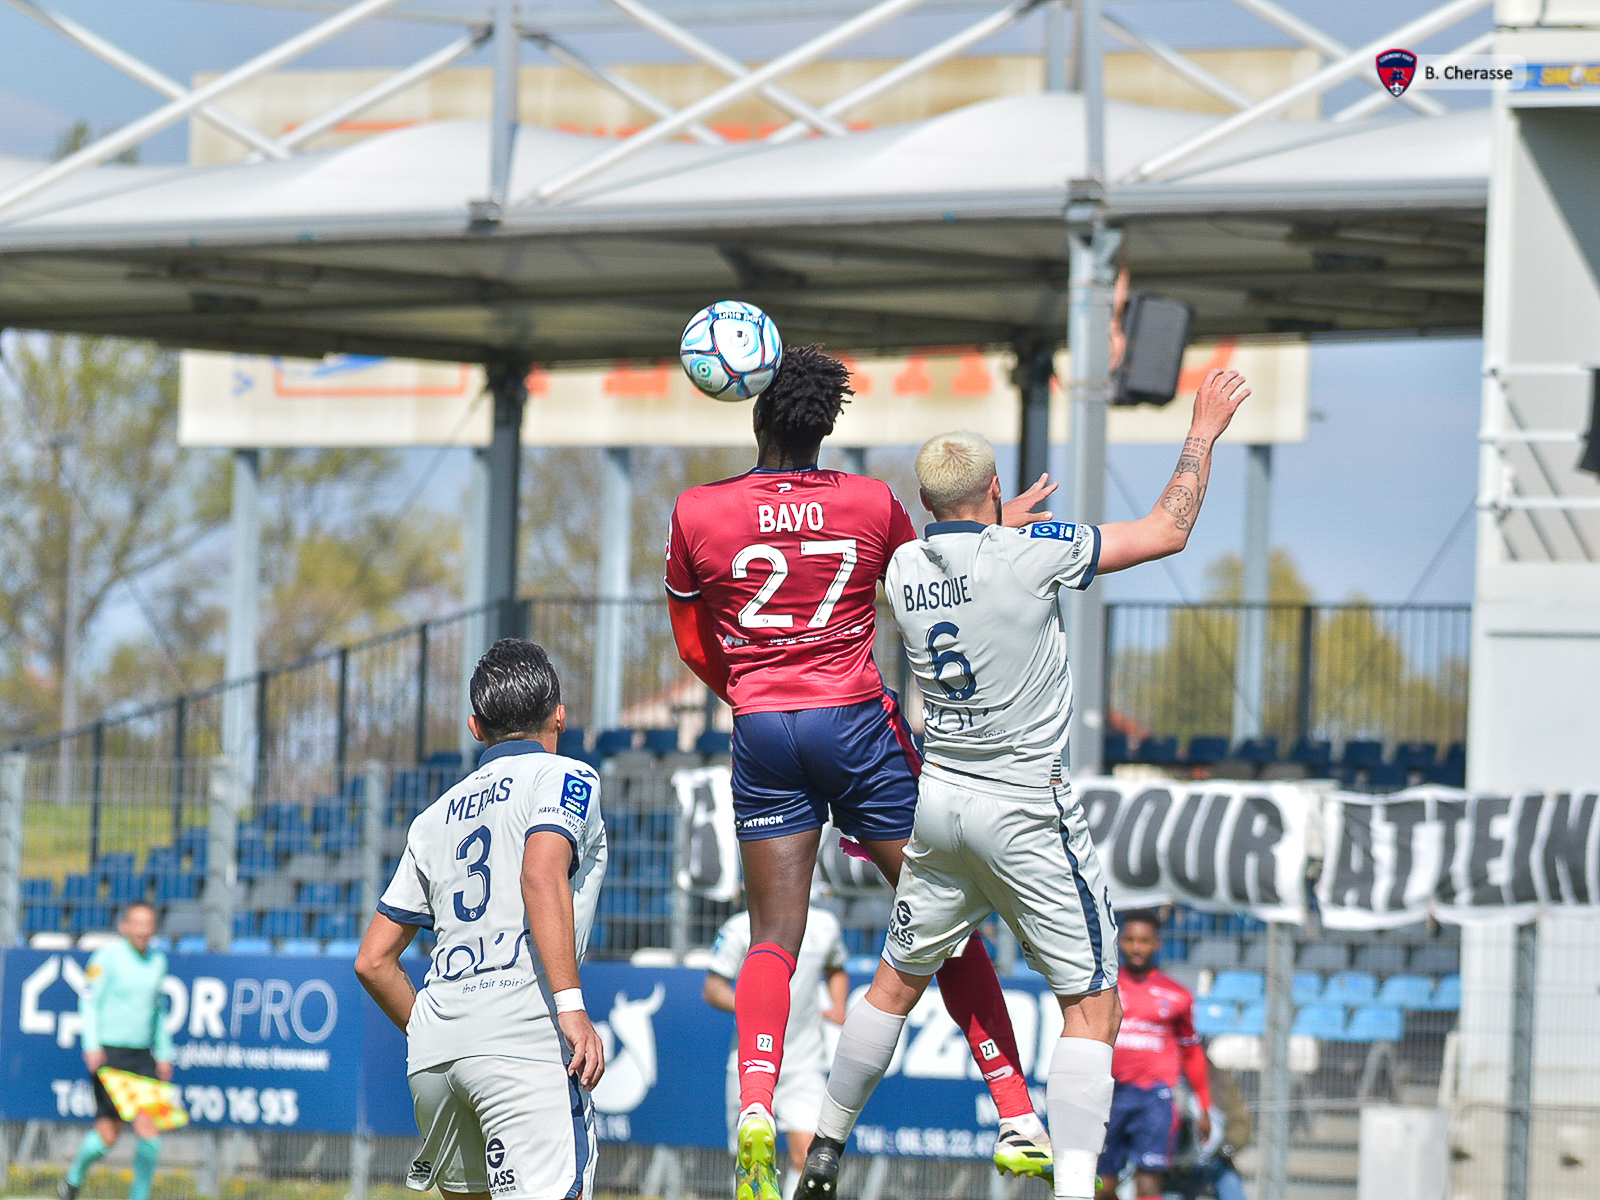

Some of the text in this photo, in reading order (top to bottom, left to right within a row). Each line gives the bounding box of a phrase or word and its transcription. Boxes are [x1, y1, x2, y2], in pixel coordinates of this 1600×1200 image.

[758, 502, 824, 533] BAYO
[731, 539, 858, 628] 27
[903, 575, 973, 612] BASQUE
[925, 621, 977, 700] 6
[743, 814, 784, 828] PATRICK
[1080, 788, 1284, 902] POUR
[453, 825, 492, 923] 3
[461, 984, 477, 995] the
[479, 978, 496, 989] fair
[759, 1037, 771, 1049] 27
[982, 1042, 996, 1057] 27
